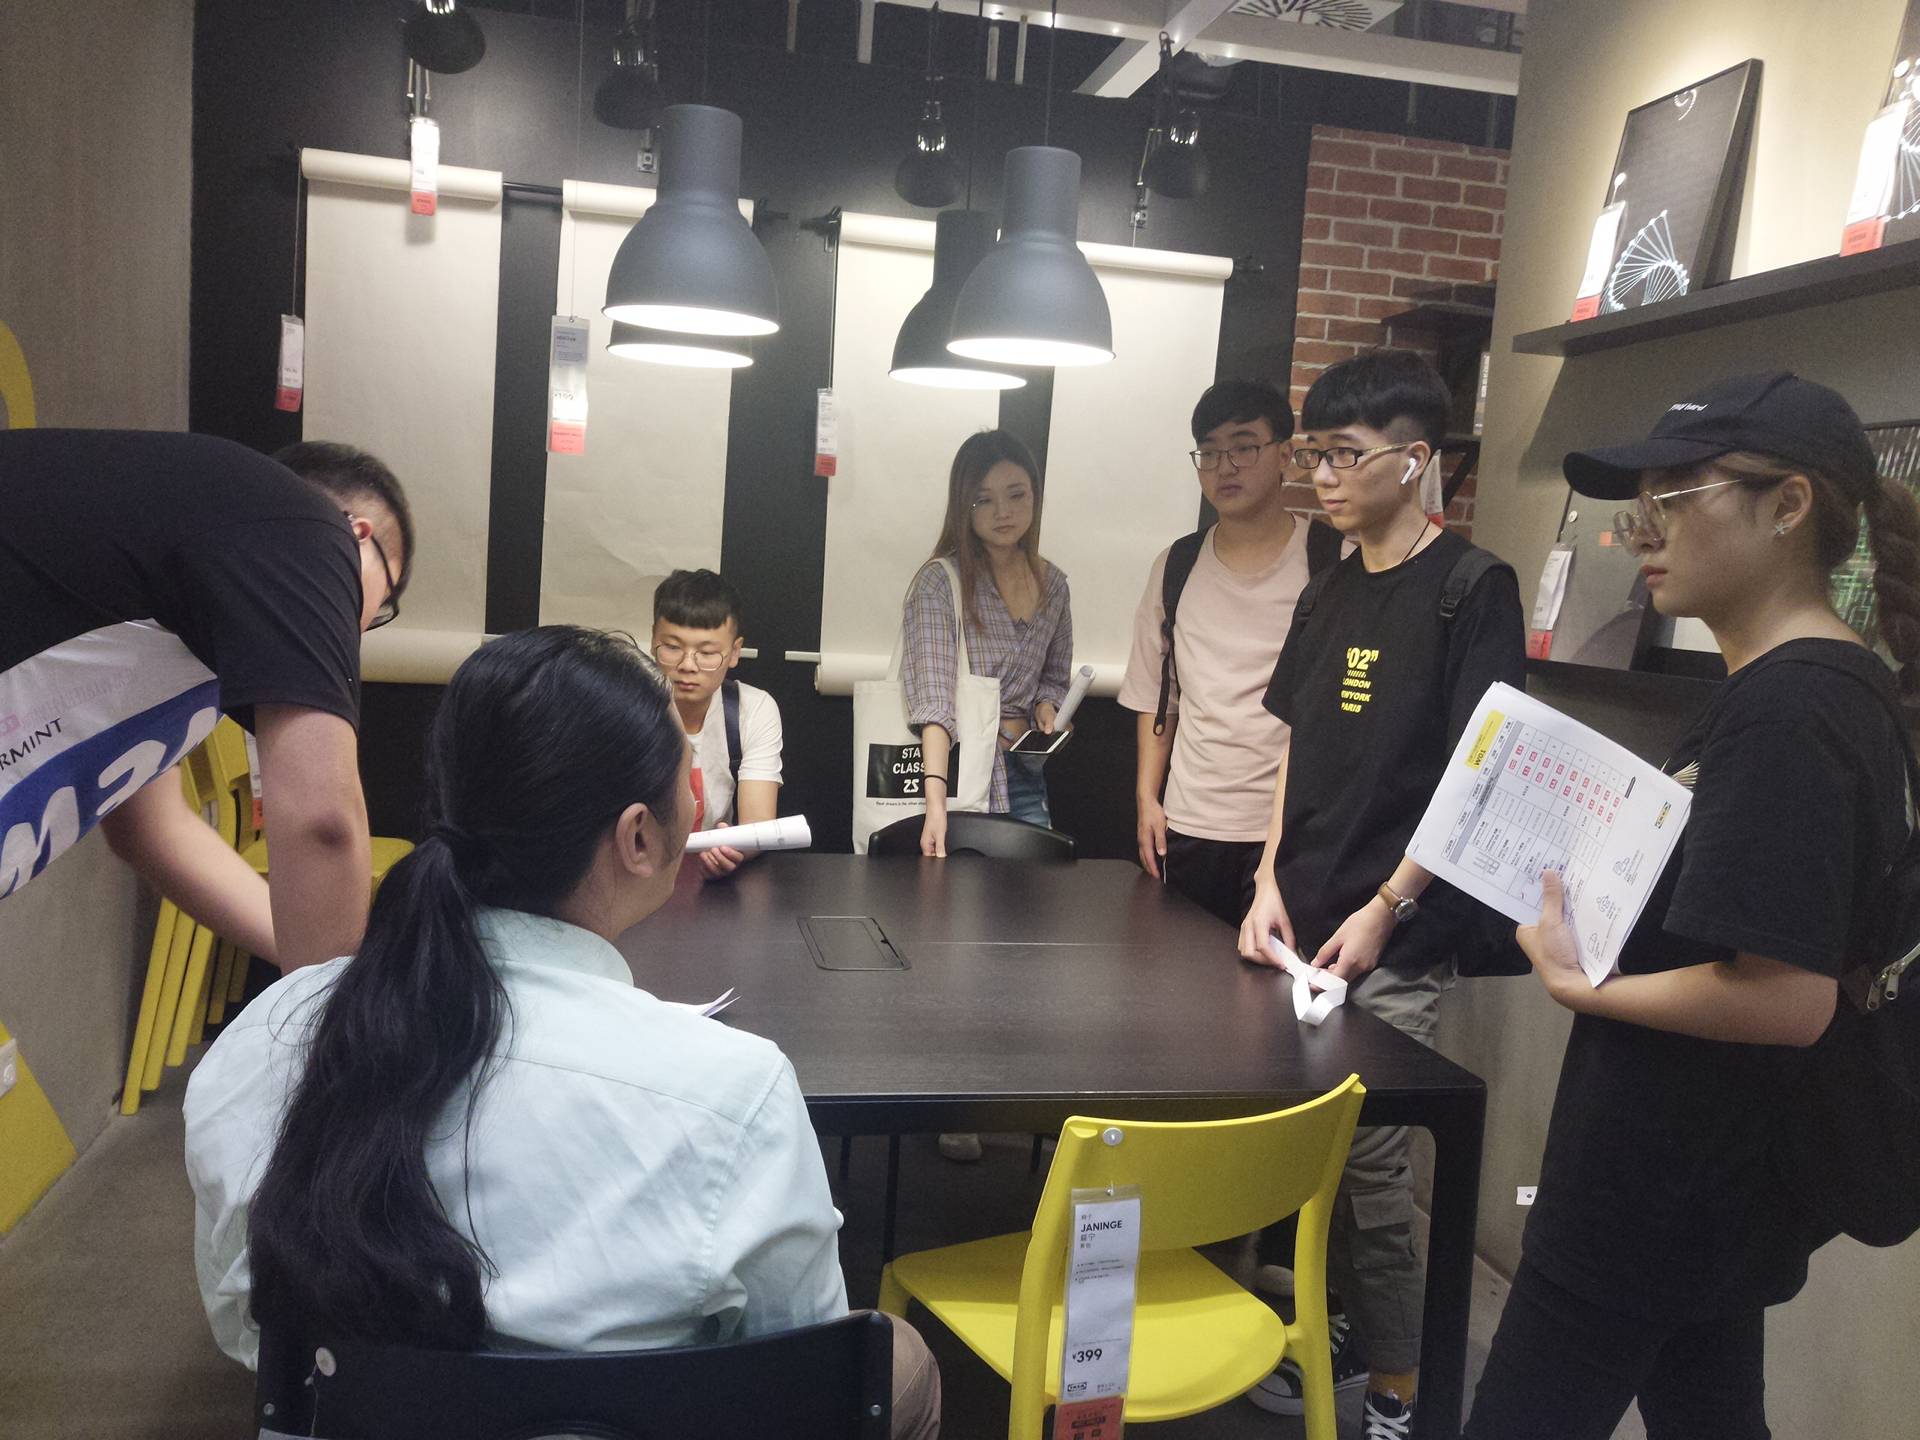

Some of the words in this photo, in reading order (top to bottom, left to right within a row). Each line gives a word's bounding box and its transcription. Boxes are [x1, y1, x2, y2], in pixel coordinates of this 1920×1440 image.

[902, 747, 921, 759] STA
[1080, 1219, 1122, 1233] JANINGE
[1072, 1348, 1103, 1363] ¥399
